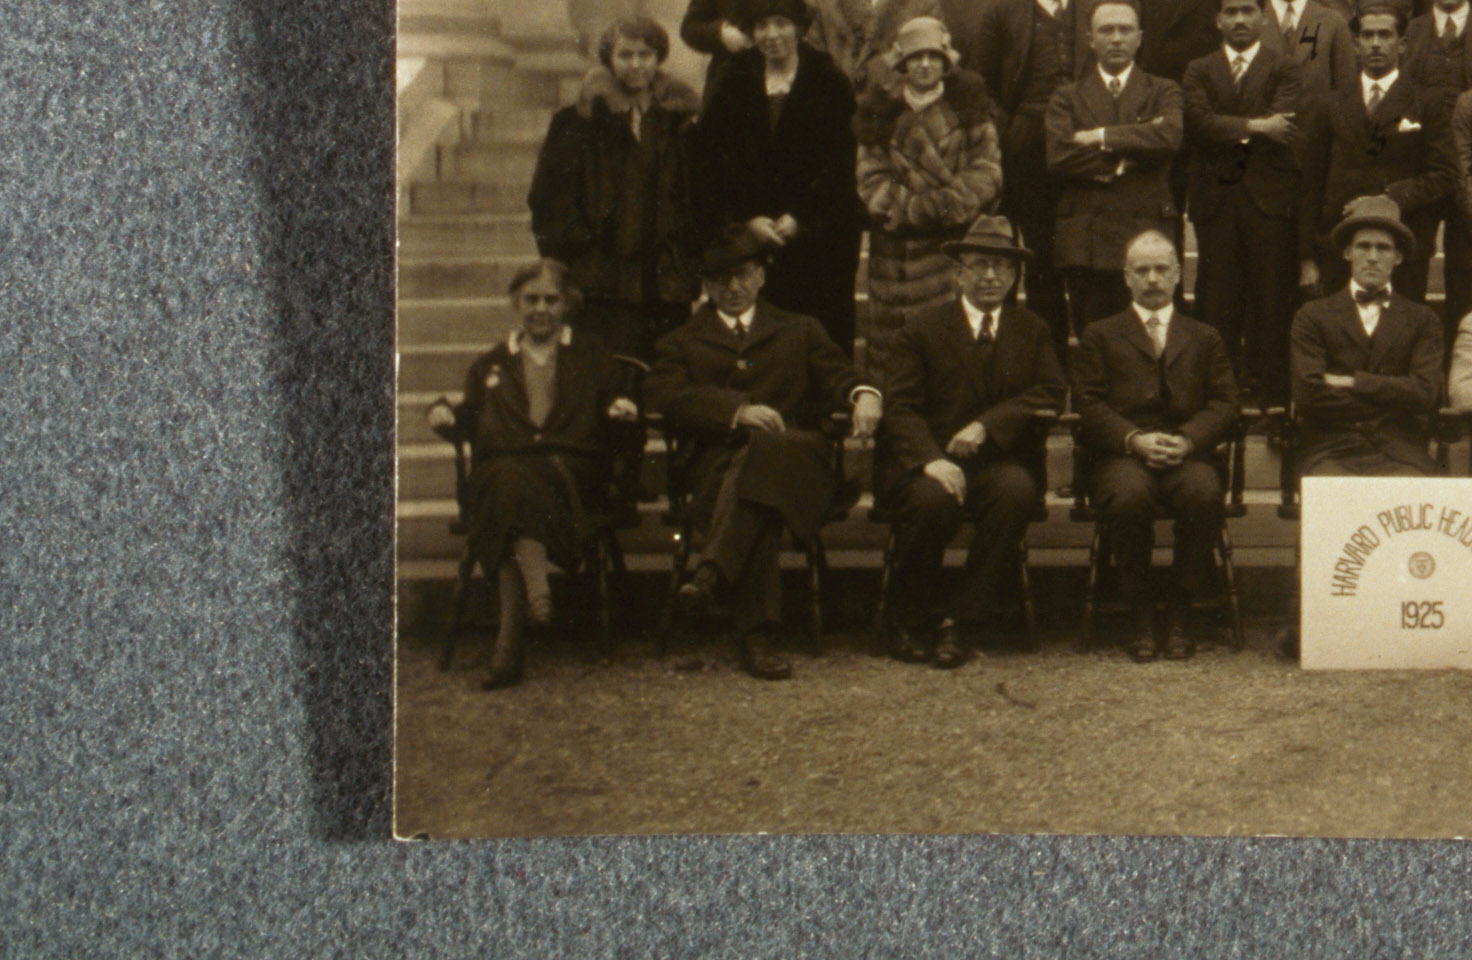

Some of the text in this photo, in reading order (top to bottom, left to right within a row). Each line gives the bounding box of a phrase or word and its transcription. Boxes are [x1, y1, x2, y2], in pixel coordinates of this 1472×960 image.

[1298, 22, 1321, 62] 4
[1331, 525, 1380, 596] HARVARD
[1378, 503, 1433, 537] PUBLIC
[1401, 601, 1445, 629] 1925
